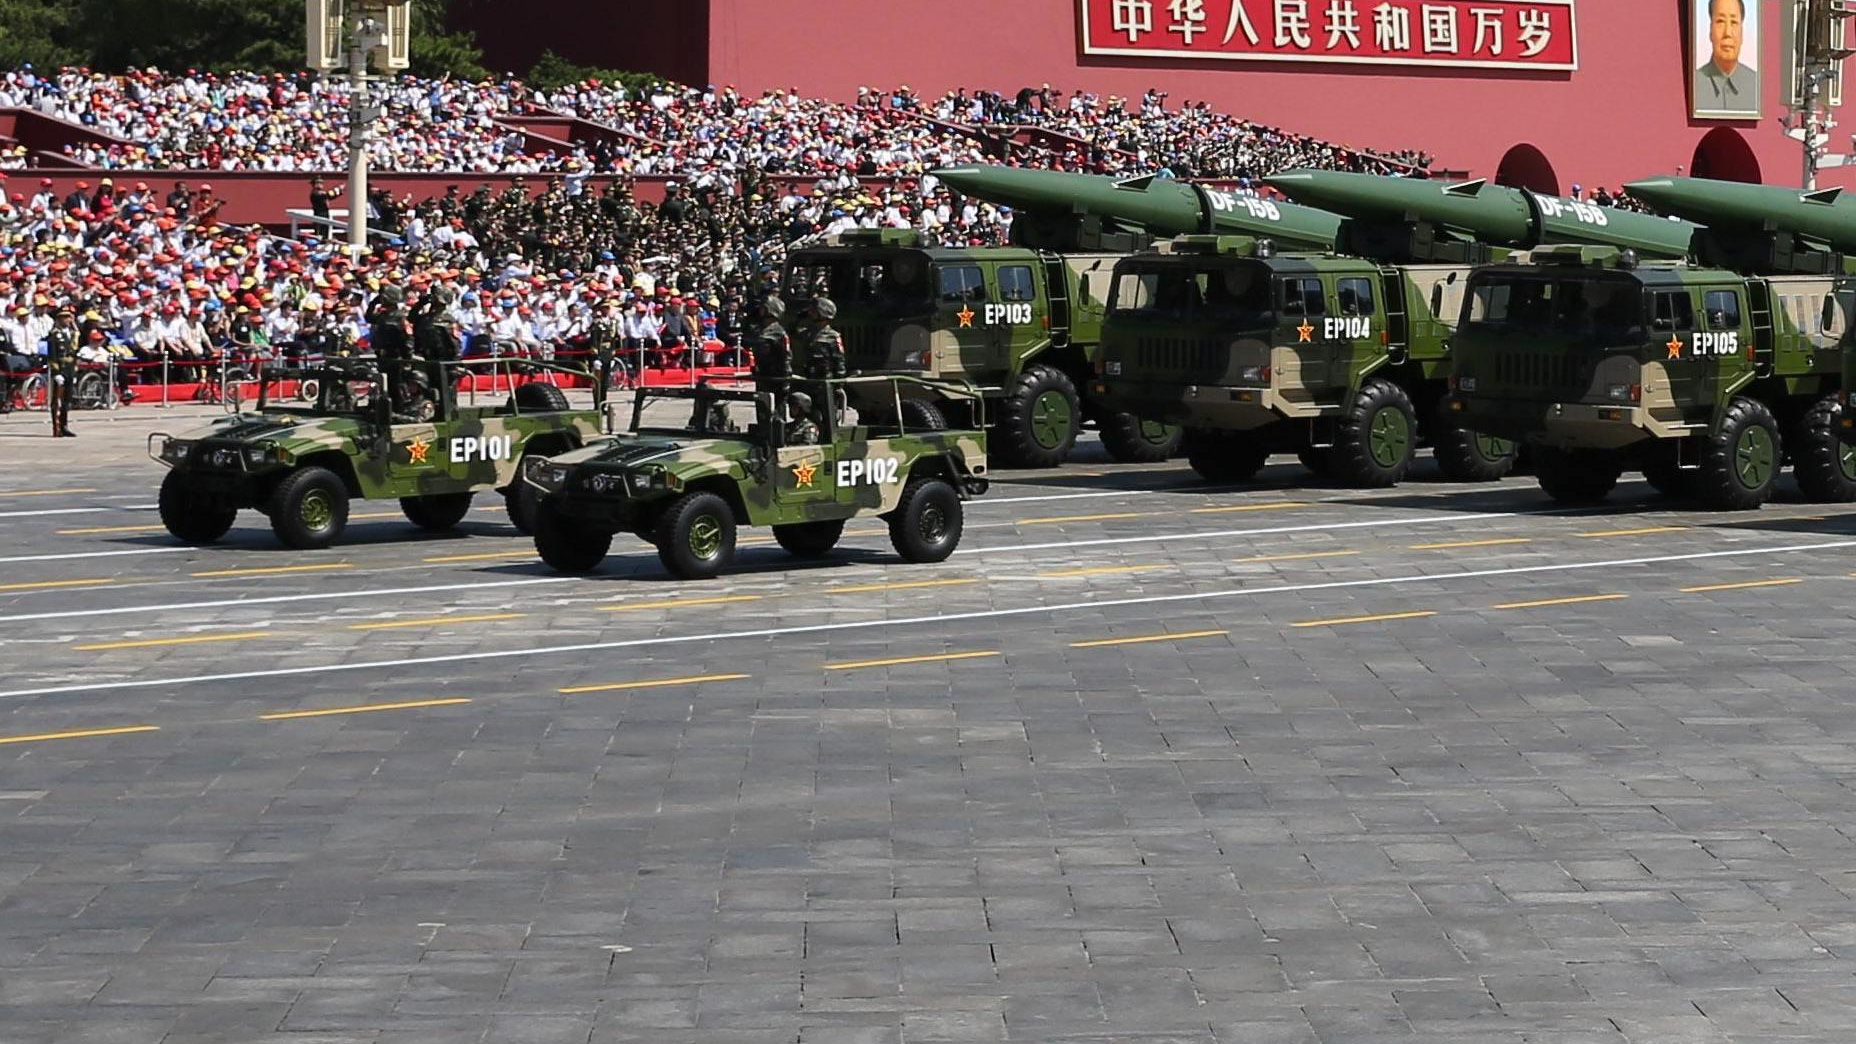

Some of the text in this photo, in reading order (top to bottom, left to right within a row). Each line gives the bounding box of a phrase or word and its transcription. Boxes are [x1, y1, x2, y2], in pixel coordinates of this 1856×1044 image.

[1206, 190, 1280, 221] DF-15B
[1534, 195, 1608, 226] DF-15B
[985, 303, 1032, 325] EP103
[1324, 317, 1370, 339] EP104
[1692, 331, 1738, 355] EP105
[450, 435, 511, 463] EP101
[837, 457, 899, 487] EP102
